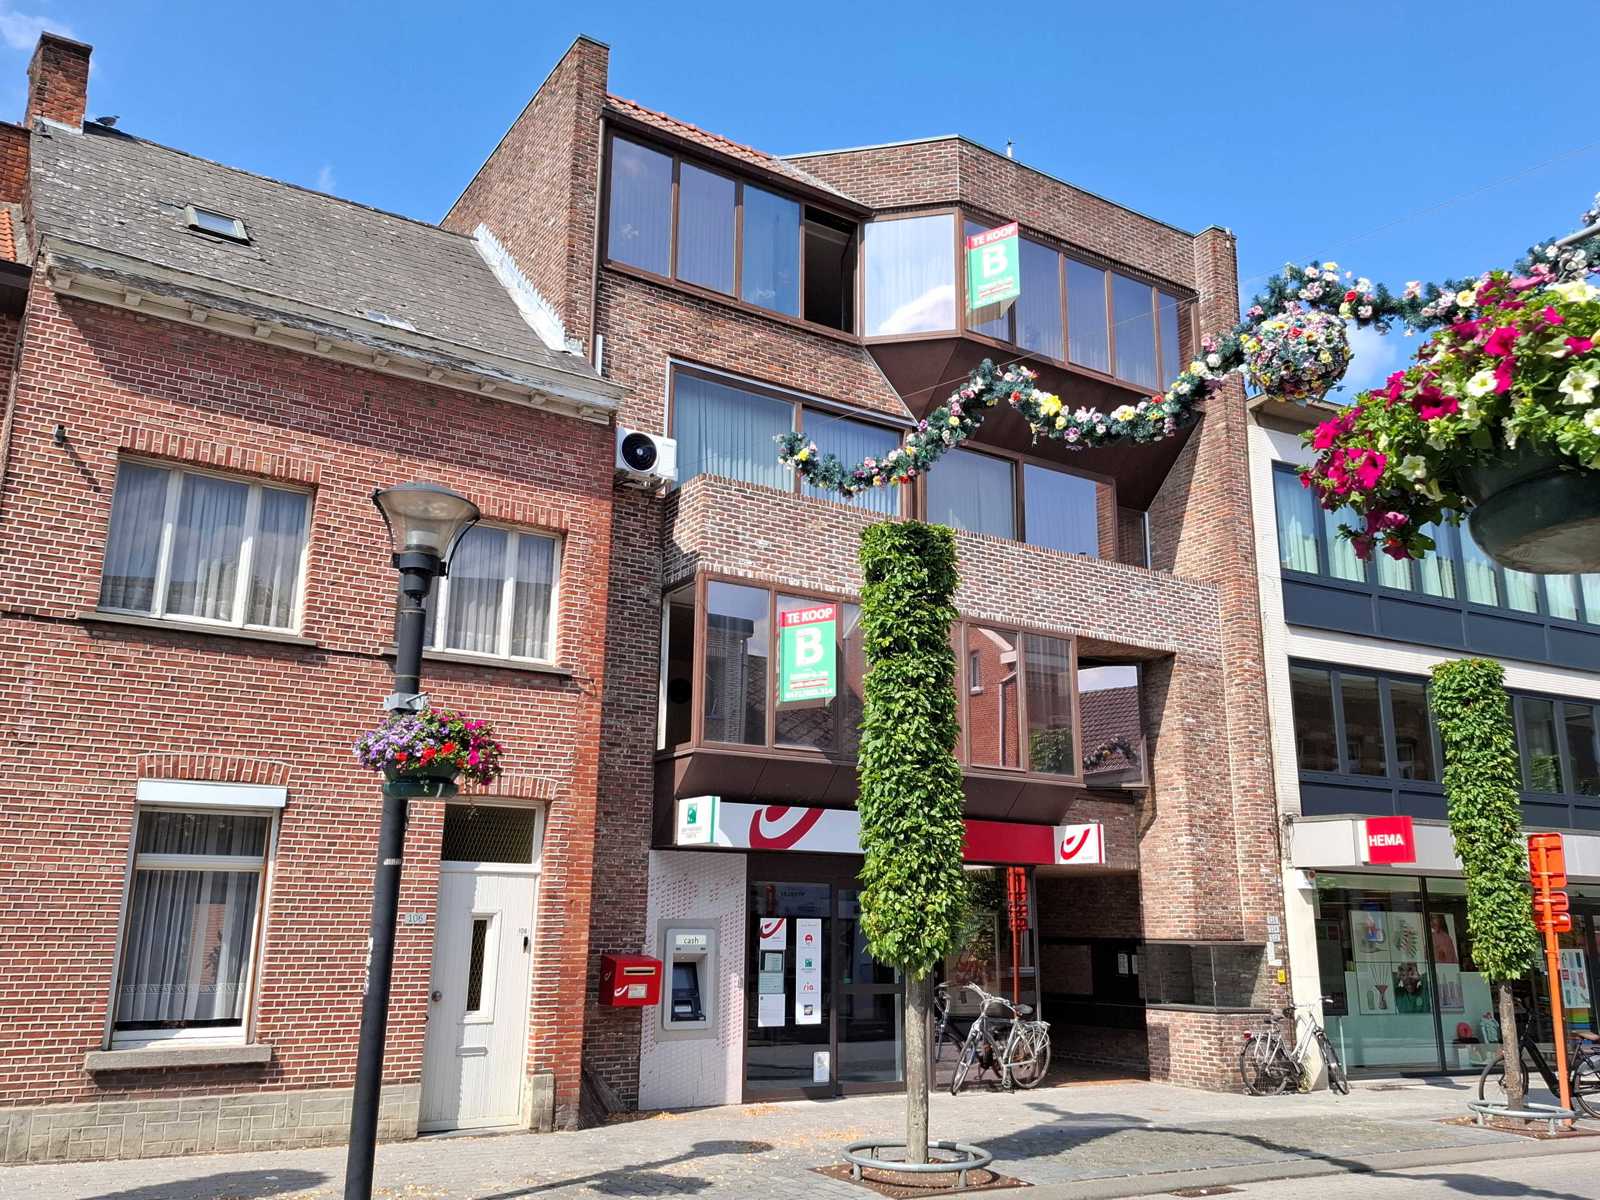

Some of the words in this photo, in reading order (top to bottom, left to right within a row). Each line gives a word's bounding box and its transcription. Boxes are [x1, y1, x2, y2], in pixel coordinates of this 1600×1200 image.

[973, 235, 985, 247] TE
[986, 226, 1014, 242] KOOP
[982, 242, 1009, 280] B
[786, 612, 801, 624] TE
[801, 607, 833, 622] KOOP
[794, 627, 824, 668] B
[1368, 833, 1405, 847] HEMA
[683, 936, 699, 945] cash
